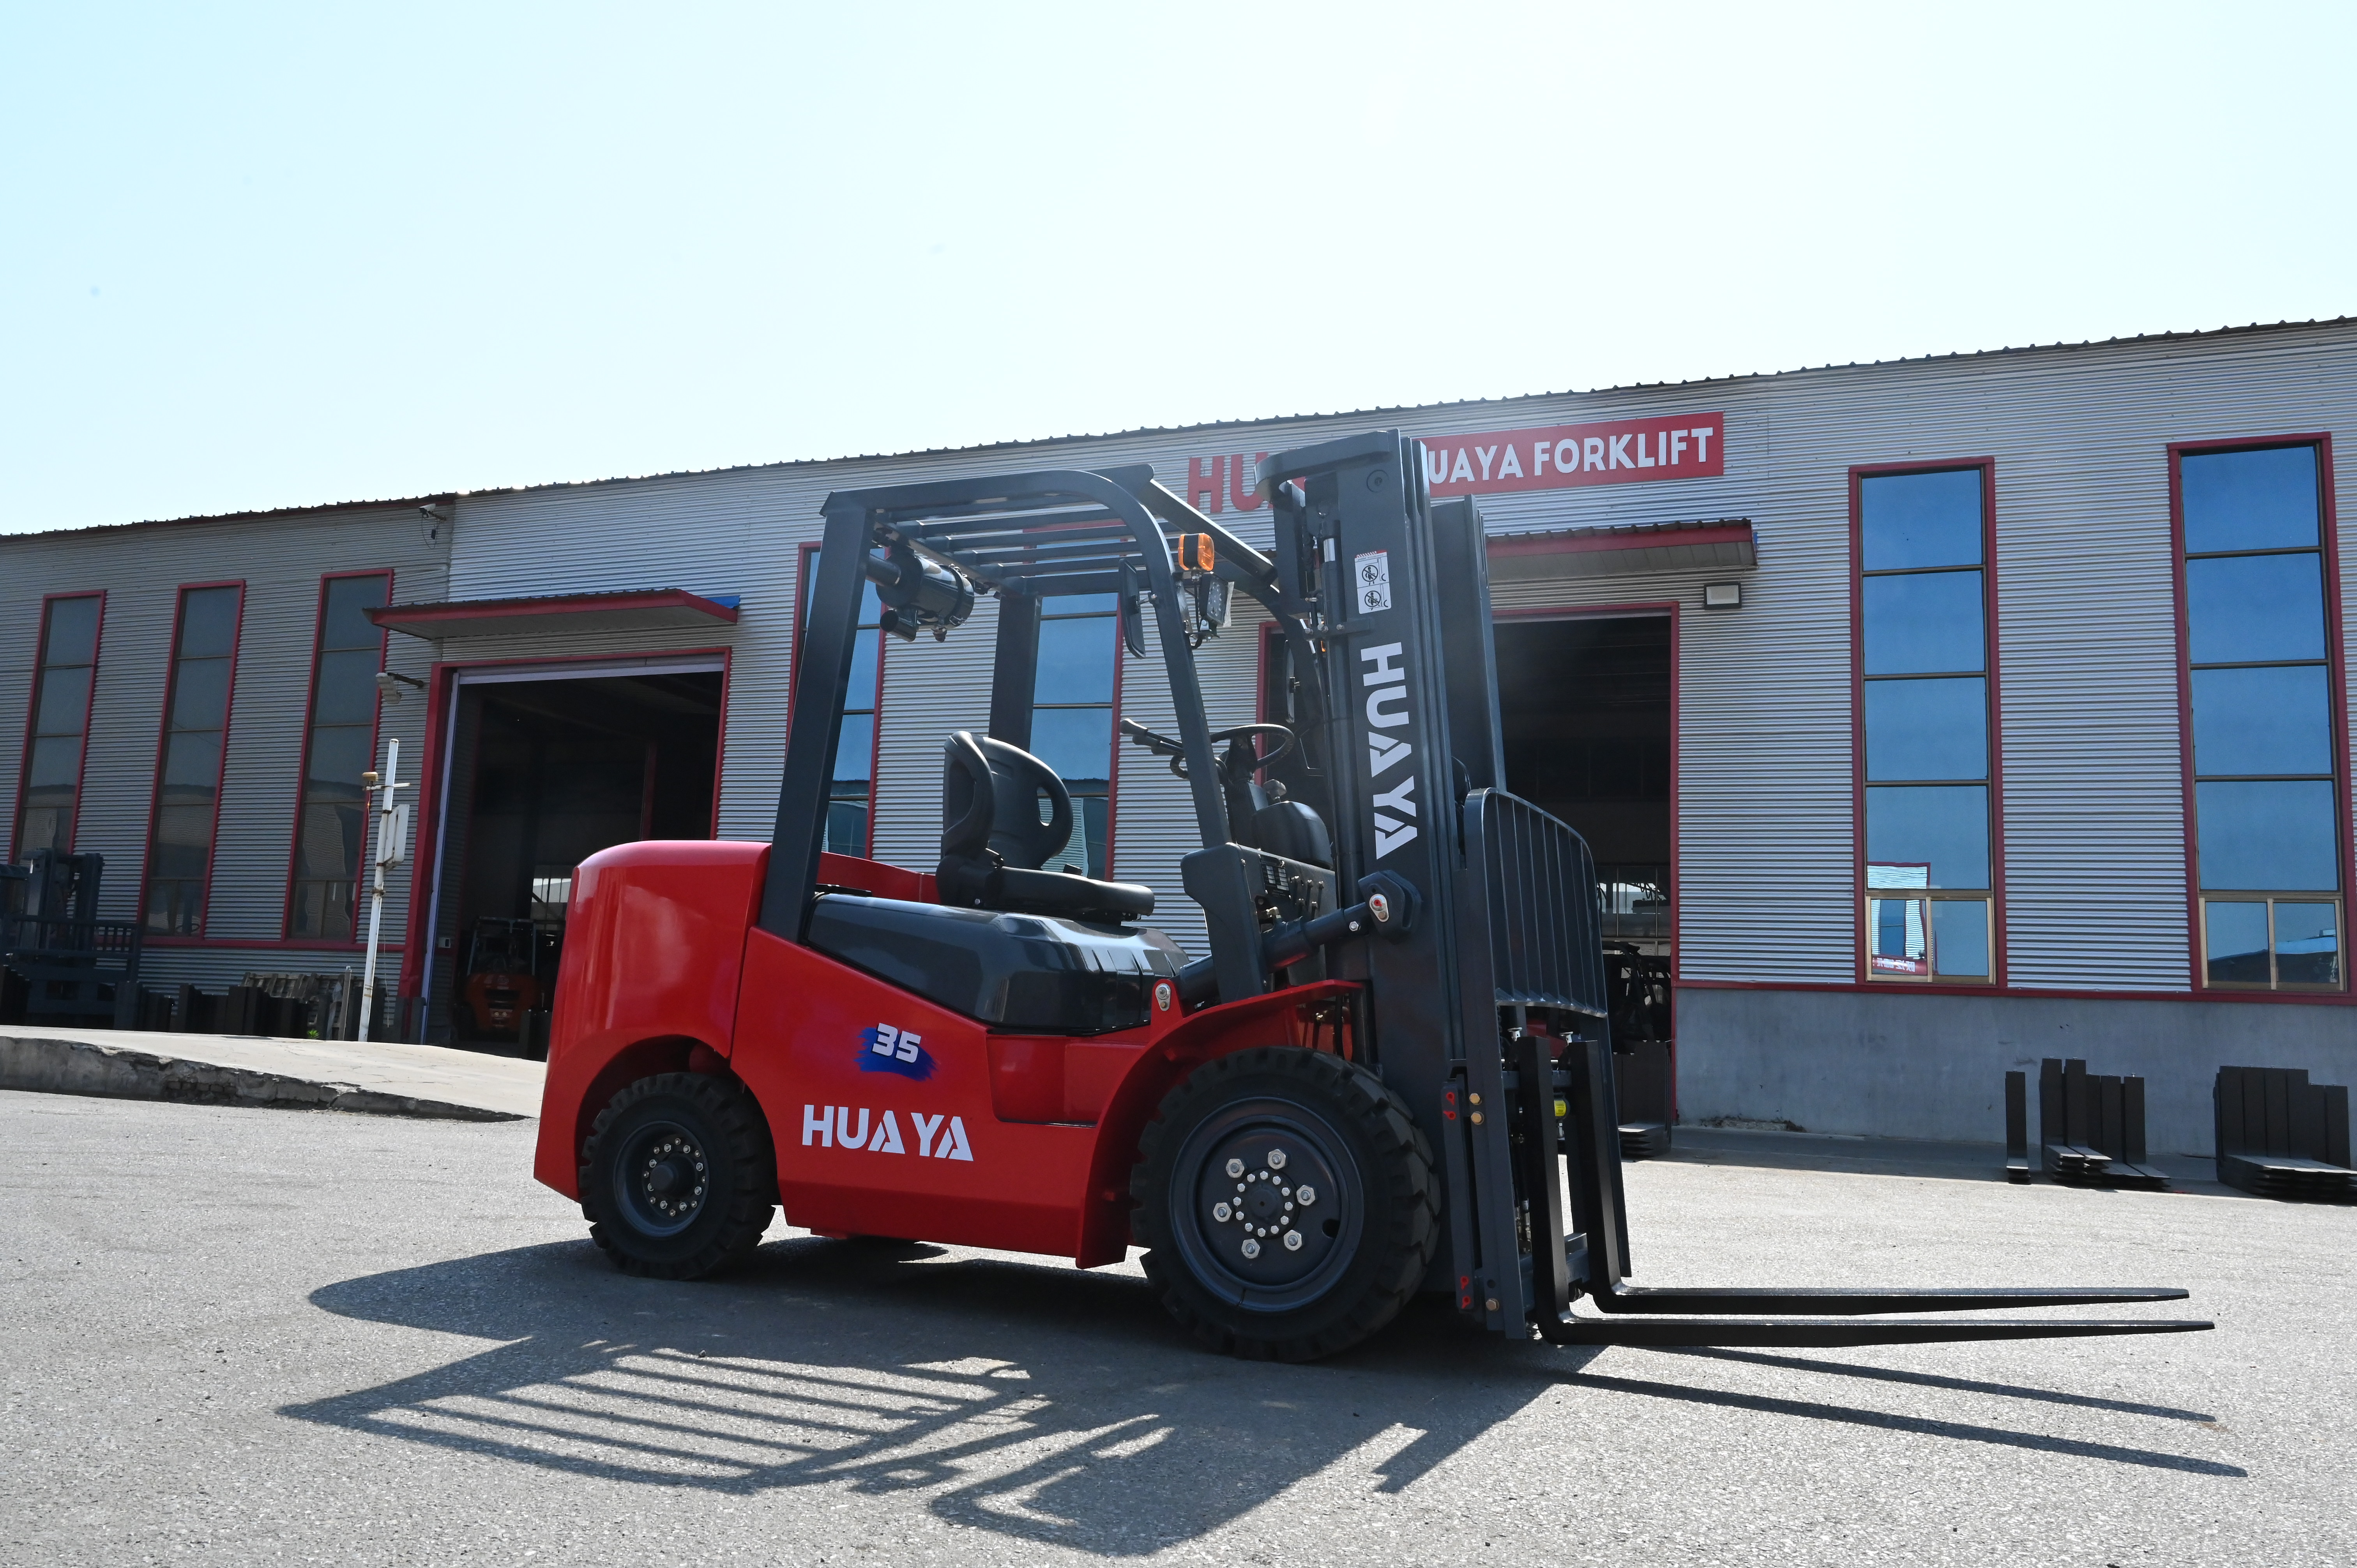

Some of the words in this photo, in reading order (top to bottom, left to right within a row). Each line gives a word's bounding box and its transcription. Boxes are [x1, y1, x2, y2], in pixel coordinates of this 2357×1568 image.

[1187, 452, 1274, 513] HU
[1428, 444, 1524, 484] UAYA
[1534, 427, 1713, 476] FORKLIFT
[1360, 642, 1418, 860] HUAYA
[872, 1022, 922, 1063] 35
